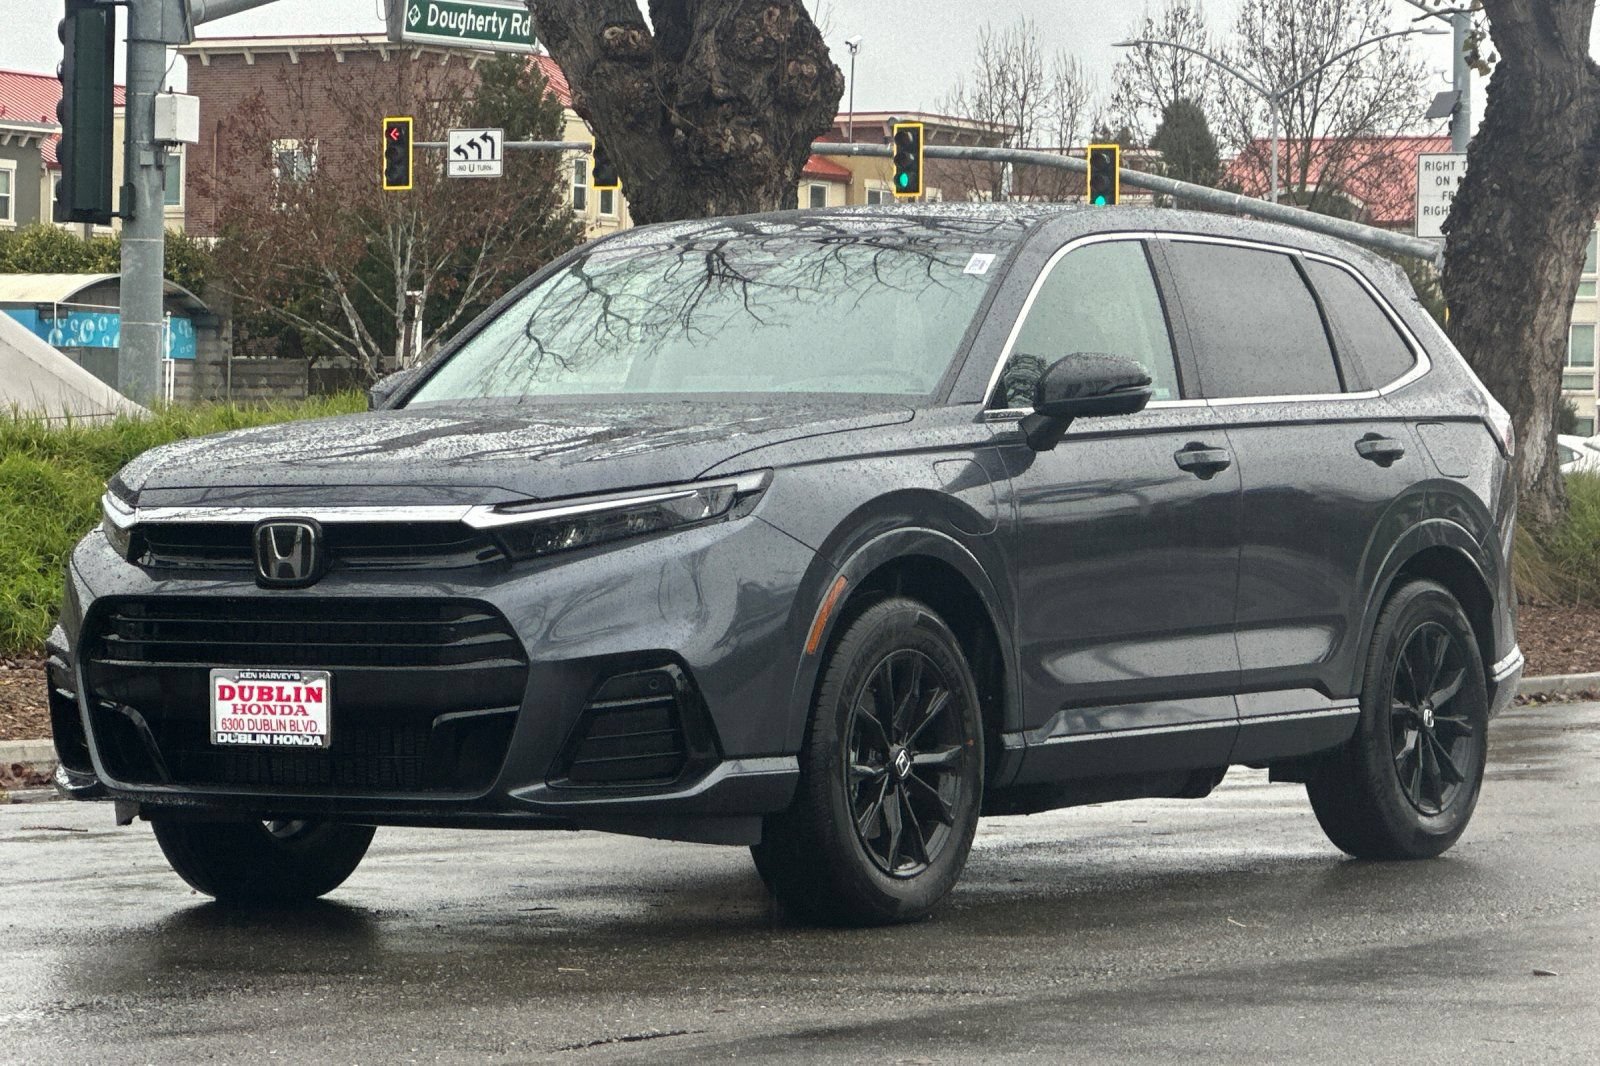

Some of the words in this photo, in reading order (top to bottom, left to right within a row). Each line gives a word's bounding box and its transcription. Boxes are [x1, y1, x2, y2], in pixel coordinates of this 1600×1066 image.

[427, 3, 507, 39] Dougherty
[510, 12, 531, 36] Rd
[469, 163, 474, 172] U
[1424, 161, 1456, 171] RIGHT
[1435, 176, 1450, 186] ON
[1442, 190, 1455, 200] FR
[1423, 205, 1450, 216] RIGH
[259, 672, 300, 680] HARVEY'S
[218, 685, 322, 703] DUBLIN
[231, 703, 309, 716] HONDA
[221, 718, 244, 731] 6300
[248, 719, 286, 732] DUBLIN
[290, 720, 320, 733] BLVD.
[217, 733, 270, 744] DUBLIN
[273, 735, 322, 746] HONDA
